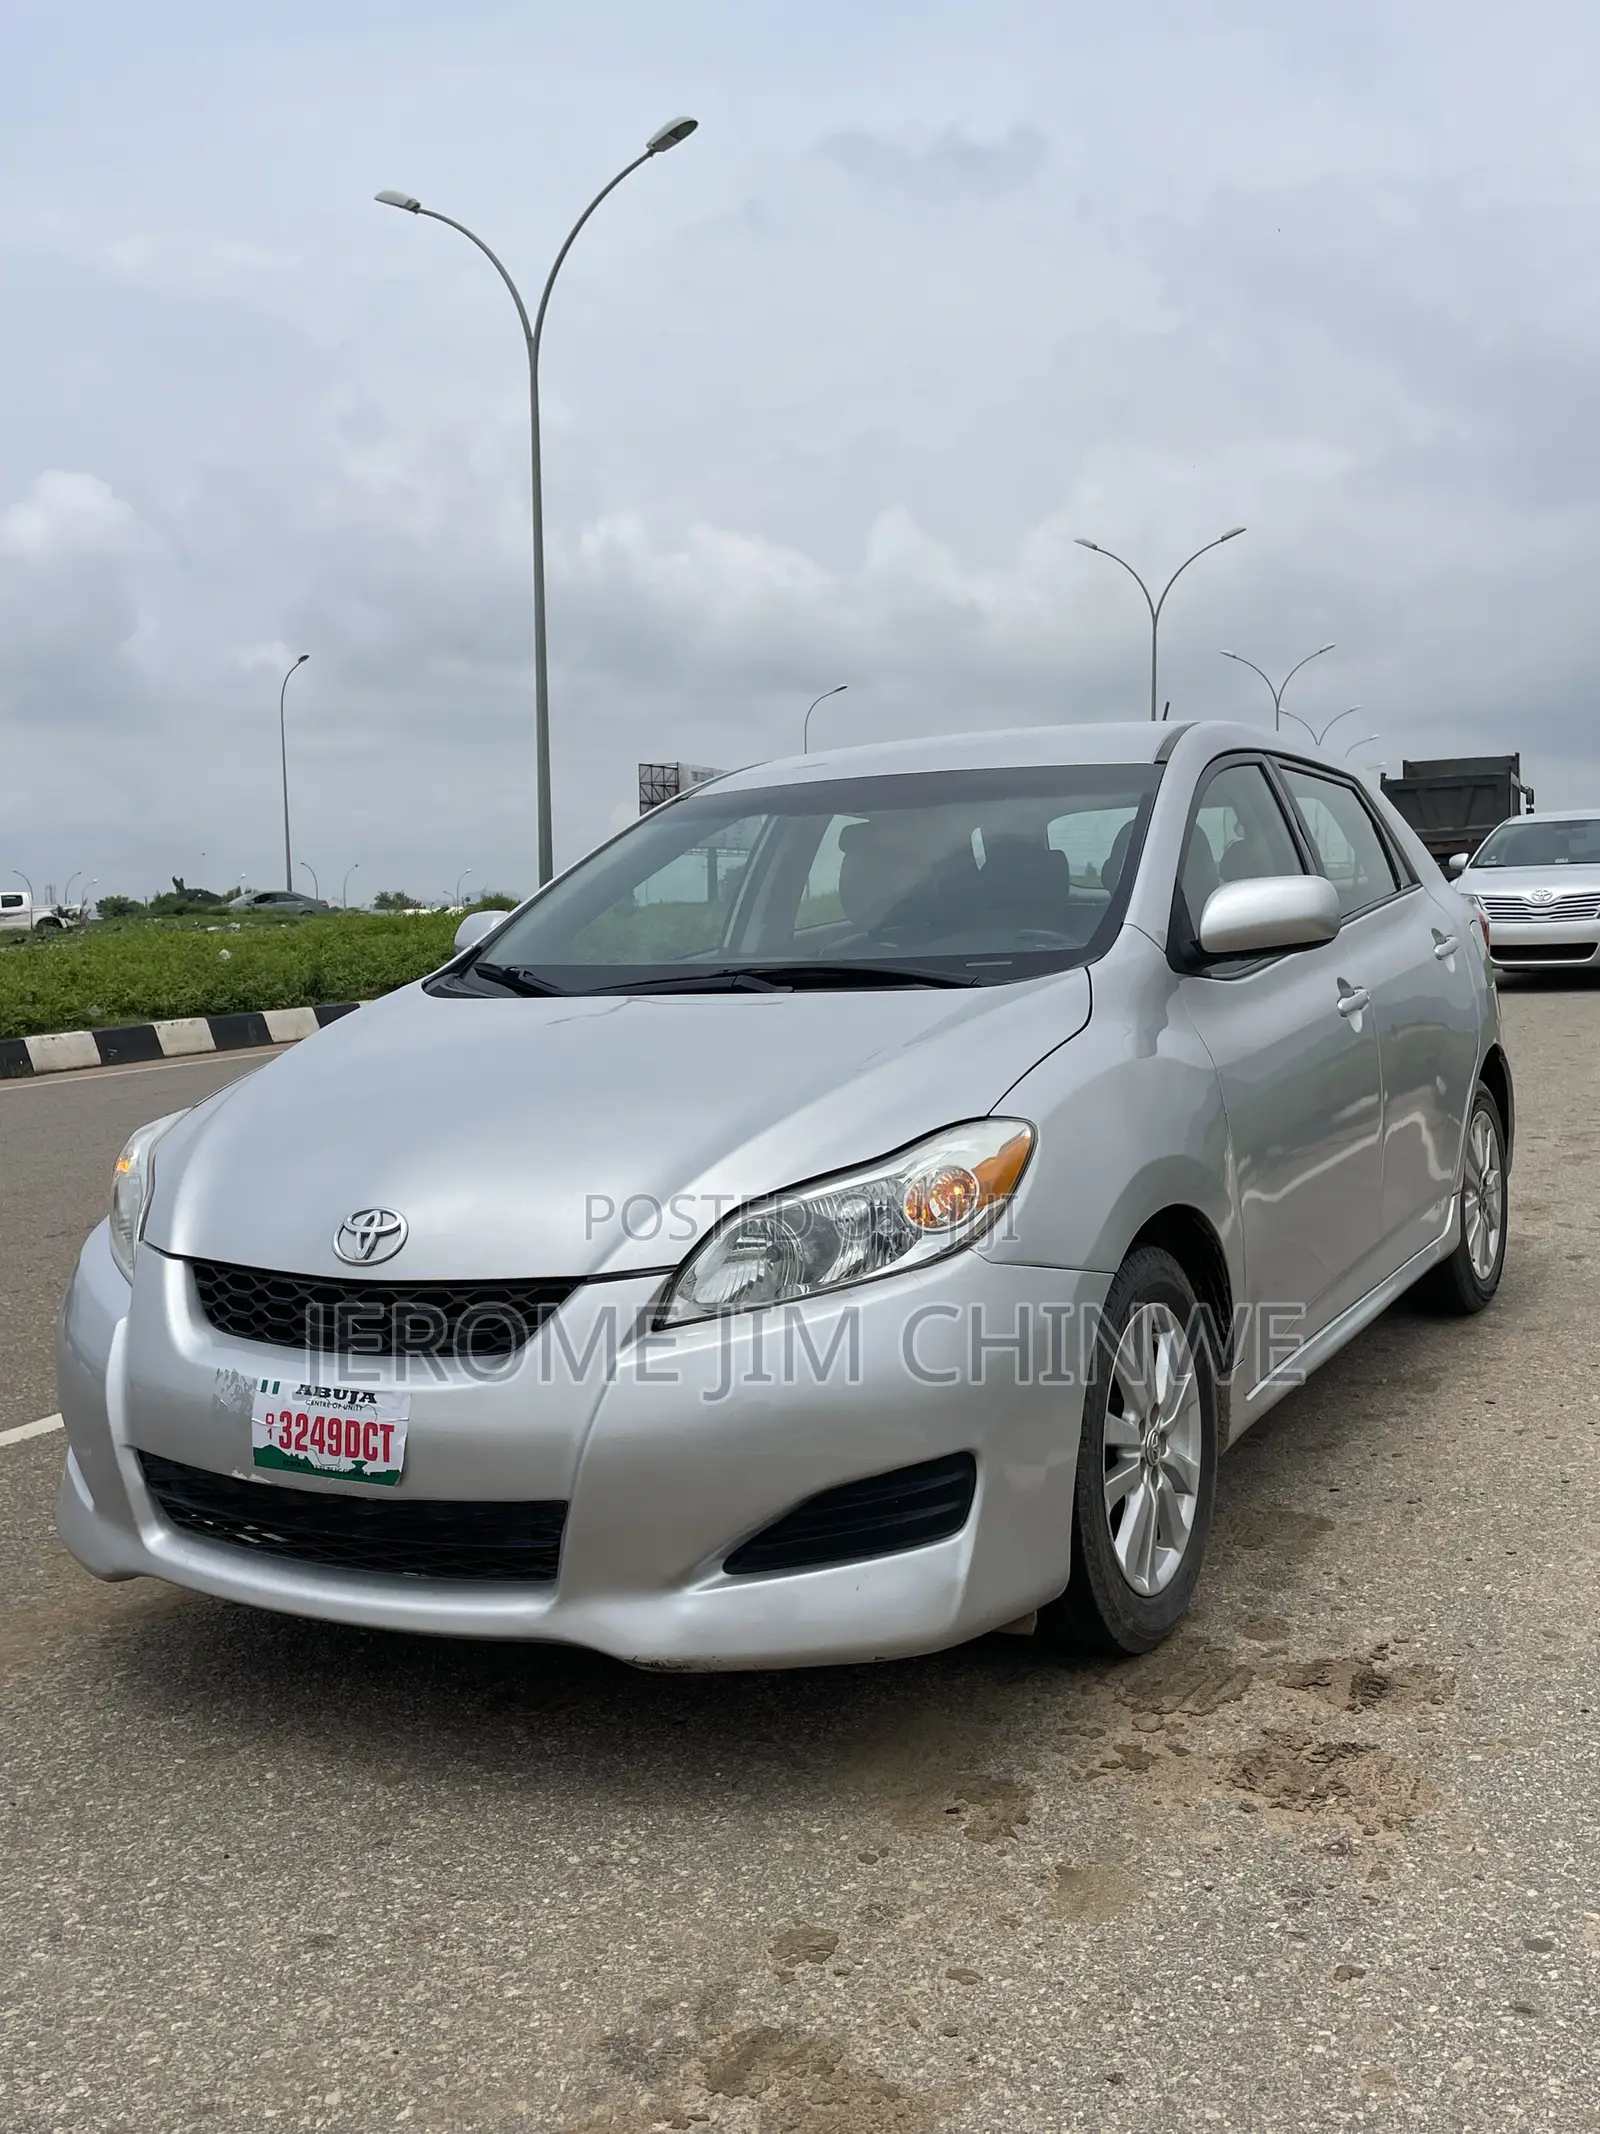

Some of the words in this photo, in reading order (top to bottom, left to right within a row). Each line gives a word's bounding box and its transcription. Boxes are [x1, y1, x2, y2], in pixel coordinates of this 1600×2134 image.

[295, 1383, 377, 1405] ABUJA
[305, 1399, 330, 1408] CENTRE
[279, 1411, 395, 1463] 3249DCT
